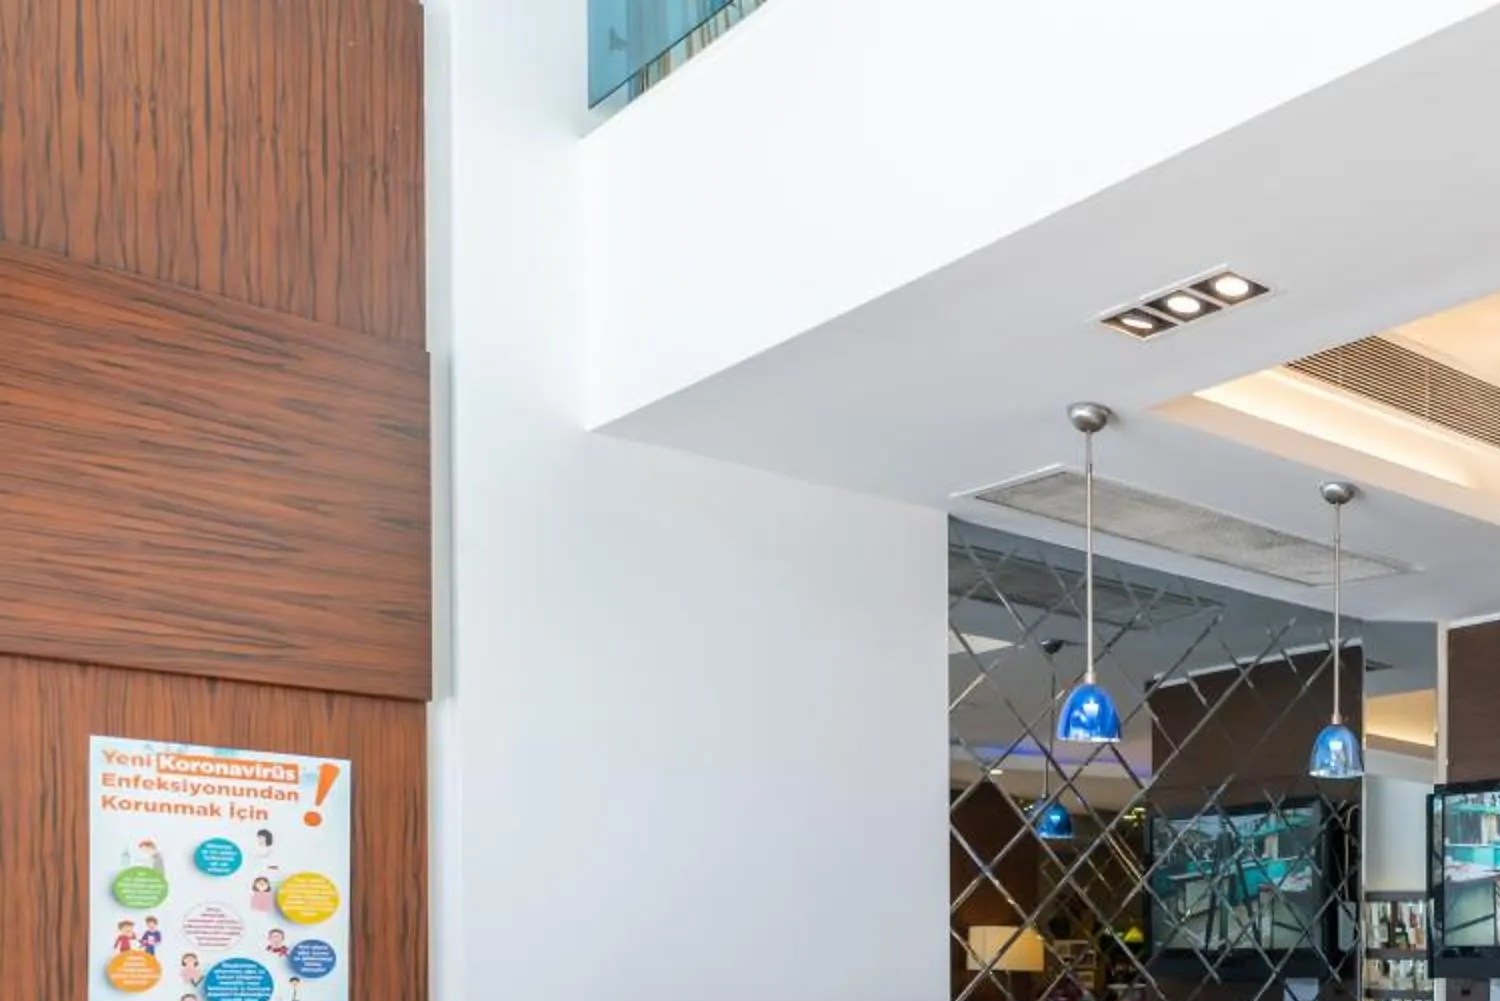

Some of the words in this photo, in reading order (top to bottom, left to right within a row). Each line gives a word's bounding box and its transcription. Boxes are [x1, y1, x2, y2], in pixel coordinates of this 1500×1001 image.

[102, 748, 151, 767] Yeni
[160, 755, 296, 781] Koronavirüs
[102, 773, 299, 802] Enfeksiyonundan
[102, 795, 222, 818] Korunmak
